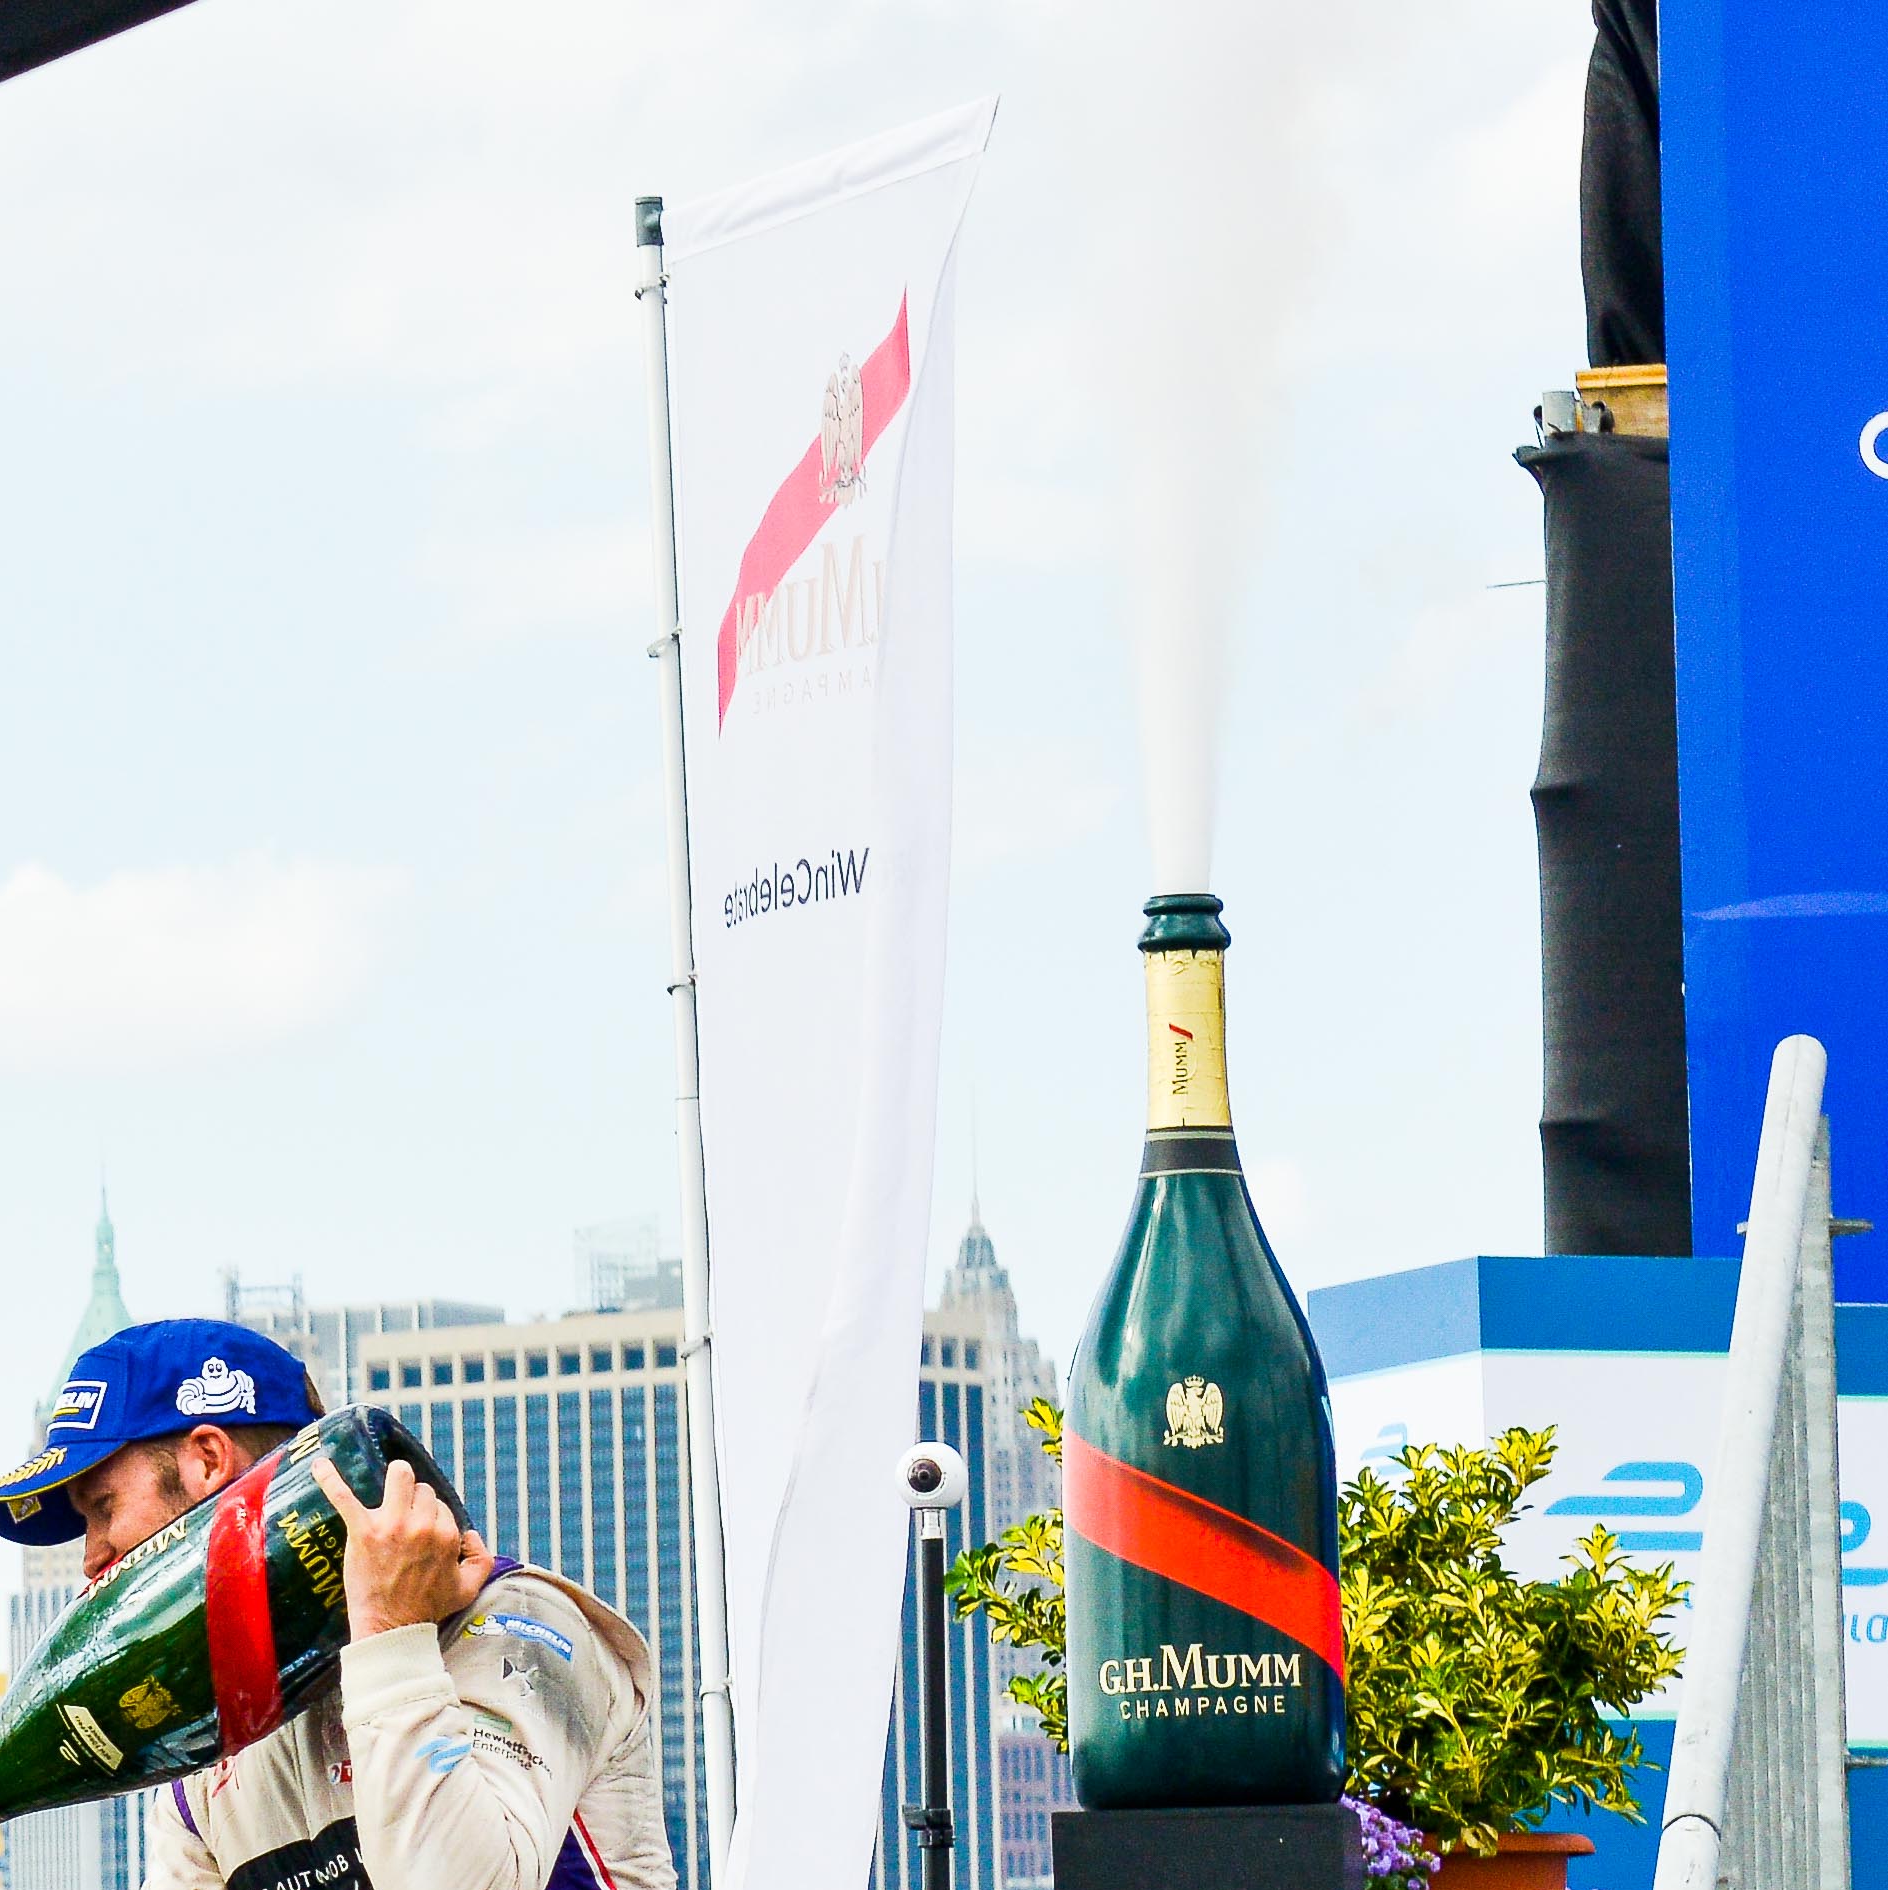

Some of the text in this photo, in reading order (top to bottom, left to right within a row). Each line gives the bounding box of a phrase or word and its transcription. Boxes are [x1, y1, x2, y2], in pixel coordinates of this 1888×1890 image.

[1172, 1041, 1189, 1095] MUMM
[309, 1511, 345, 1568] AGNE
[505, 1619, 573, 1654] MICHELIN
[1119, 1695, 1286, 1720] CHAMPAGNE
